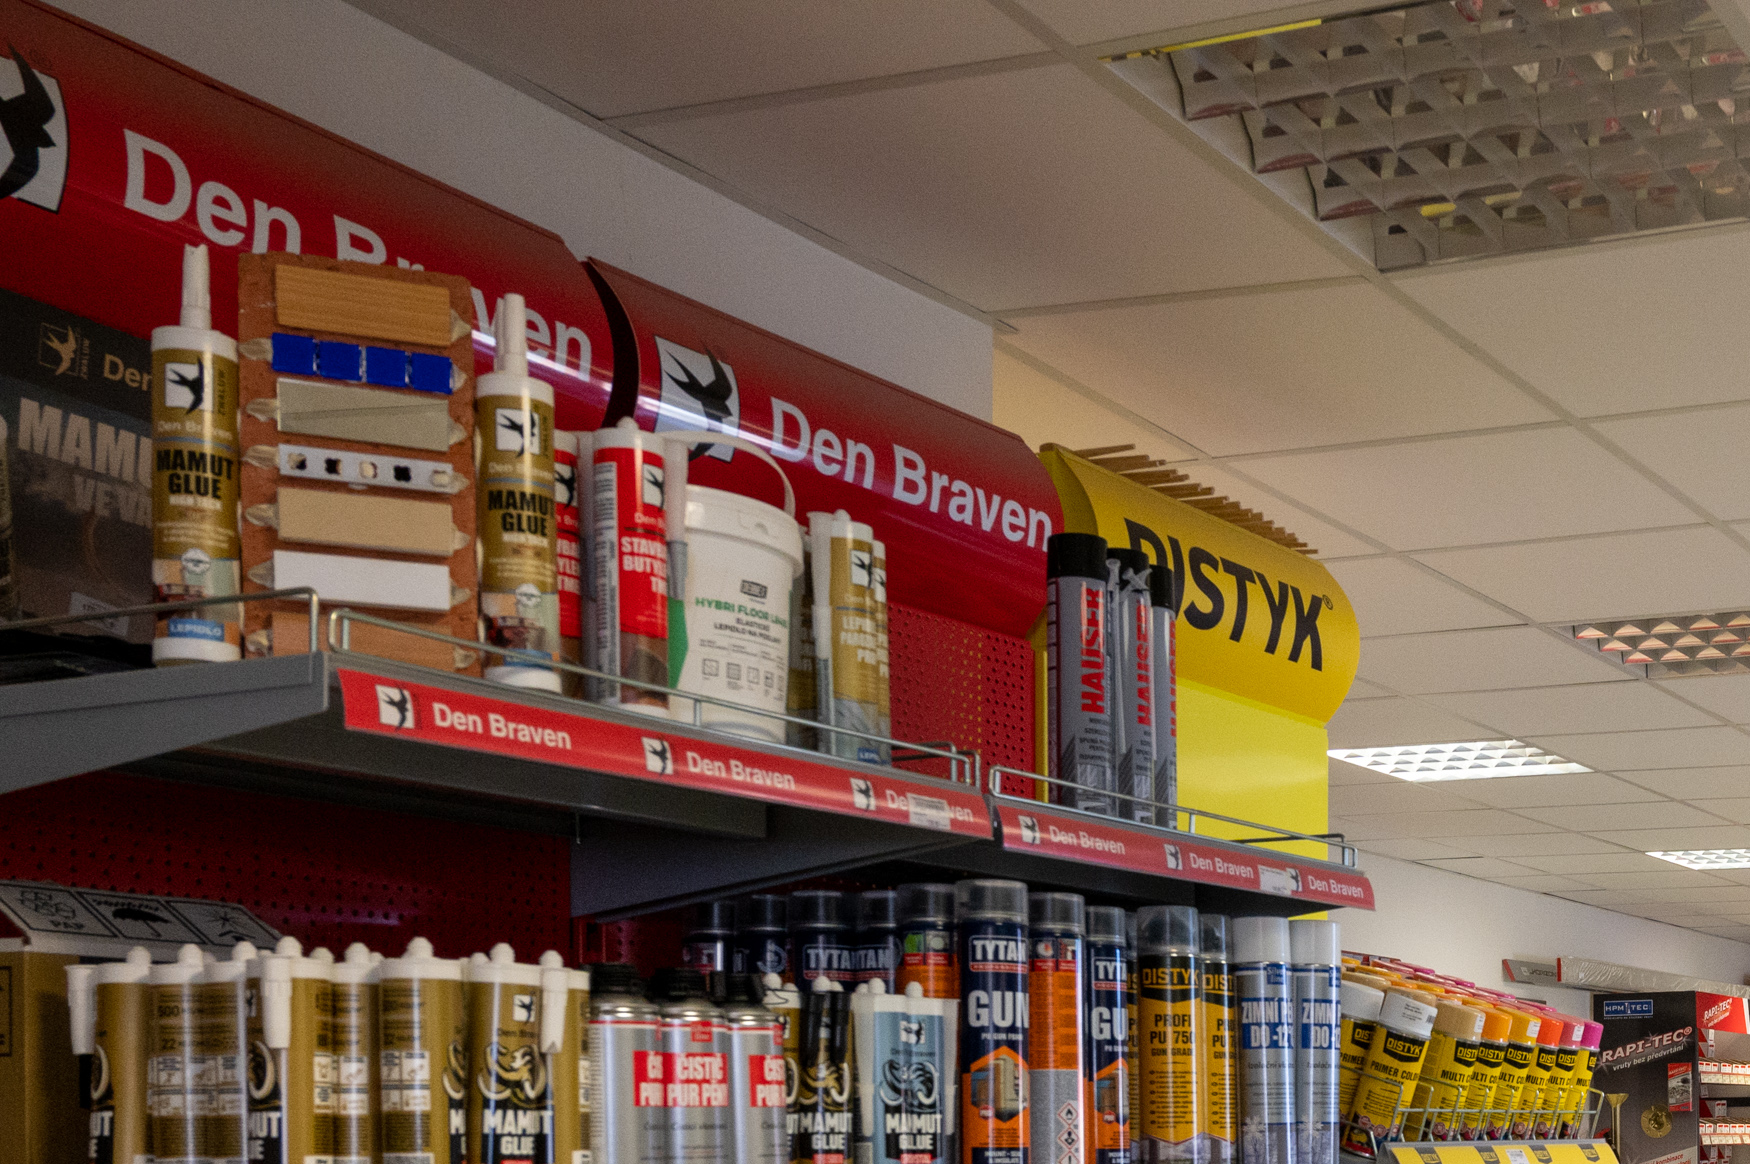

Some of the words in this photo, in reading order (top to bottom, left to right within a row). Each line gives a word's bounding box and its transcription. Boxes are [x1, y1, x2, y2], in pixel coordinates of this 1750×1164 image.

[124, 128, 301, 255] Den
[156, 449, 235, 480] MAMUT
[770, 395, 875, 492] Den
[892, 444, 1052, 553] Braven
[168, 471, 222, 500] GLUE
[501, 512, 548, 537] GLUE
[1080, 588, 1105, 714] HAUSER
[432, 702, 483, 735] Den
[490, 719, 572, 750] Braven
[686, 750, 727, 777] Den
[730, 757, 796, 792] Braven
[1049, 824, 1079, 844] Den
[1081, 831, 1126, 856] Braven
[1190, 852, 1214, 872] Den
[1216, 857, 1254, 880] Braven
[1308, 875, 1330, 891] Den
[1332, 878, 1364, 898] Braven
[1141, 967, 1199, 988] DISTYK
[1154, 1013, 1193, 1028] PROFI
[1242, 997, 1279, 1024] ZIMNÍ
[1605, 1003, 1624, 1011] HPM
[1631, 1003, 1649, 1011] TEC
[1150, 1030, 1167, 1044] PU
[1250, 1026, 1271, 1047] DO
[1386, 1035, 1424, 1057] DISTYK
[678, 1053, 724, 1080] ČISTIČ
[1370, 1060, 1399, 1077] PRIMER
[1613, 1060, 1632, 1072] vruty
[1633, 1056, 1646, 1065] bez
[1647, 1043, 1684, 1062] předvrtání
[483, 1106, 554, 1137] MAMUT
[500, 1136, 535, 1157] GLUE
[811, 1133, 845, 1150] GLUE
